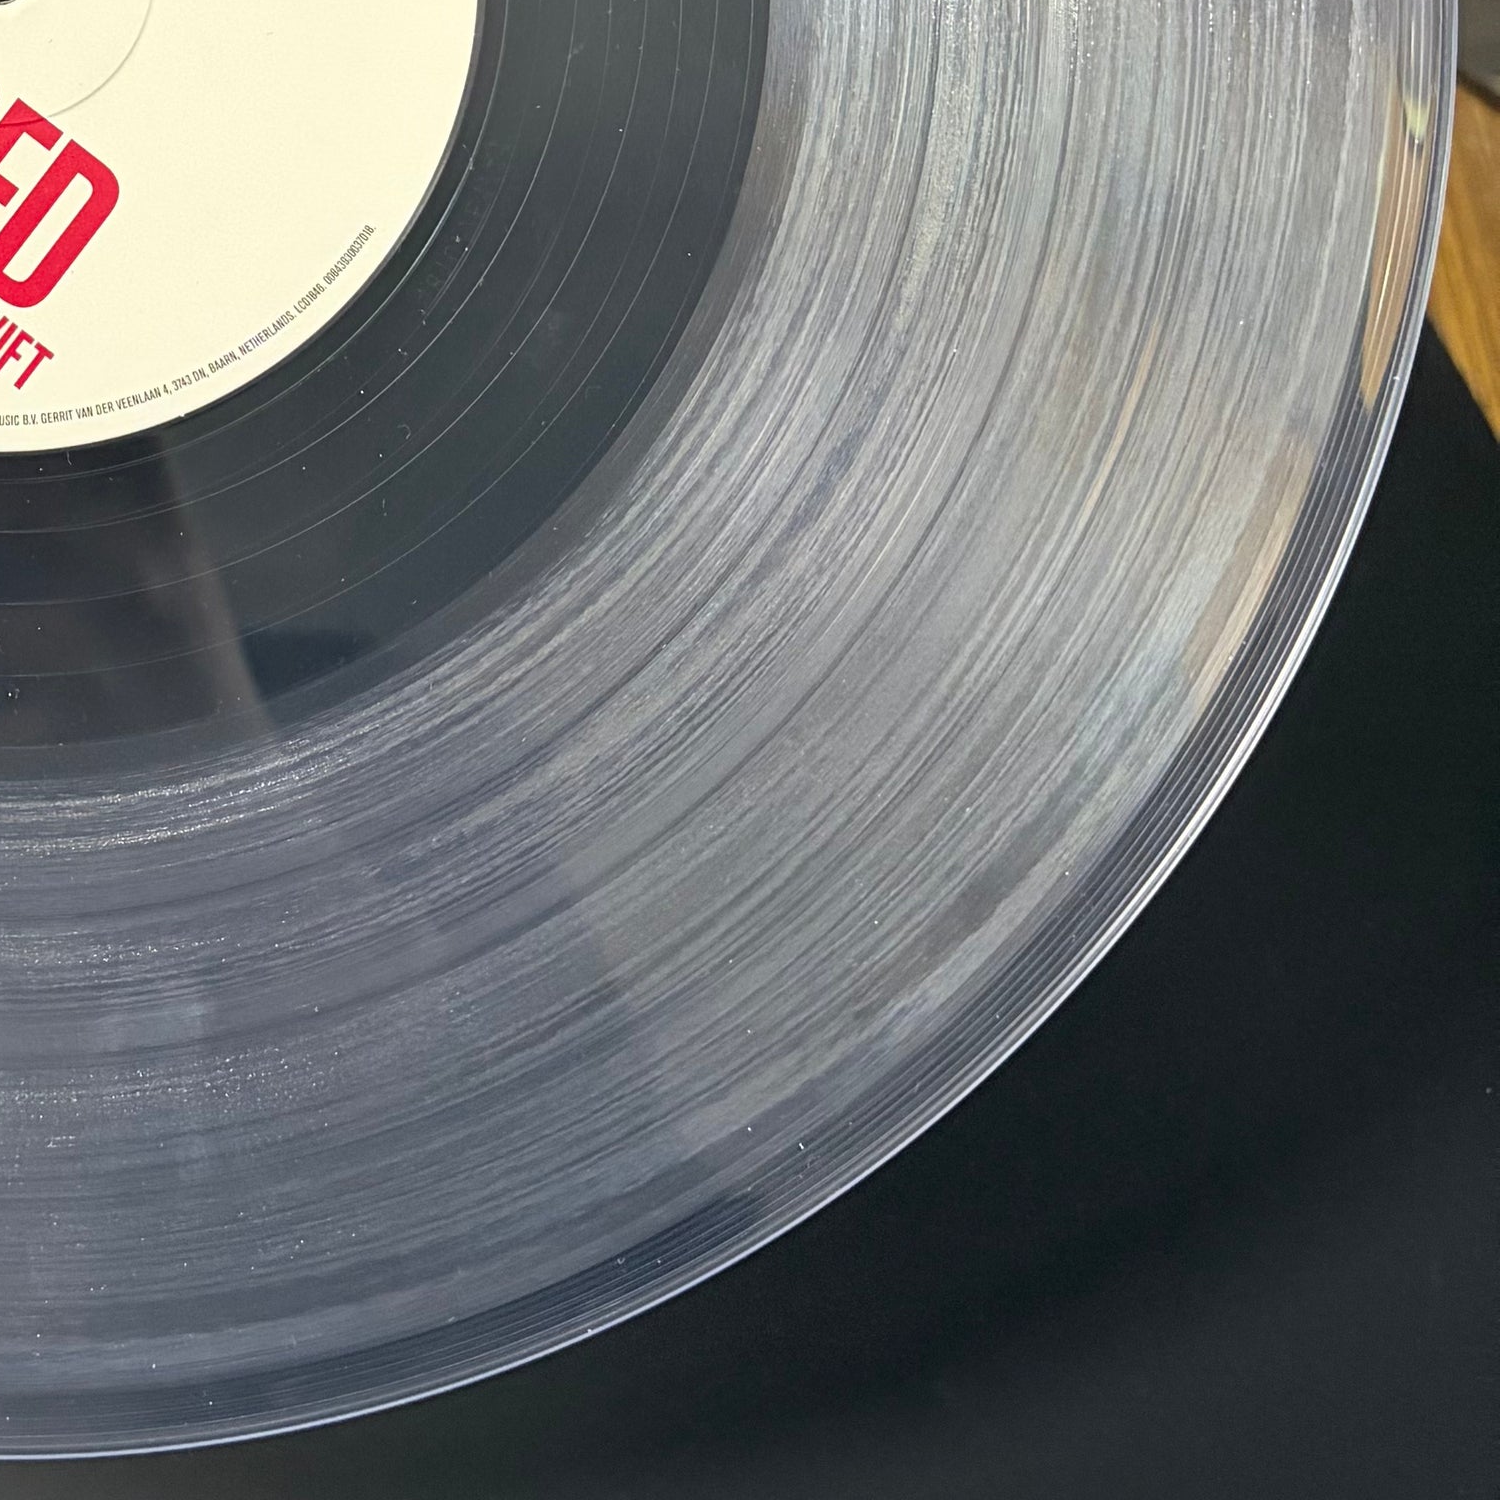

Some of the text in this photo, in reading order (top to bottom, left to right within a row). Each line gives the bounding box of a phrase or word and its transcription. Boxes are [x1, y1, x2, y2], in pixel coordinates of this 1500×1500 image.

[21, 412, 38, 426] B.V.
[39, 408, 75, 424] GERRIT
[74, 405, 94, 420] VAN
[94, 400, 115, 416] DER
[114, 385, 162, 411] VEENLAAN
[160, 381, 173, 397] 4,
[170, 372, 193, 392] 3743
[190, 365, 210, 383] DN,
[206, 347, 241, 375] BAARN,
[236, 306, 297, 357] NETHERLANDS.
